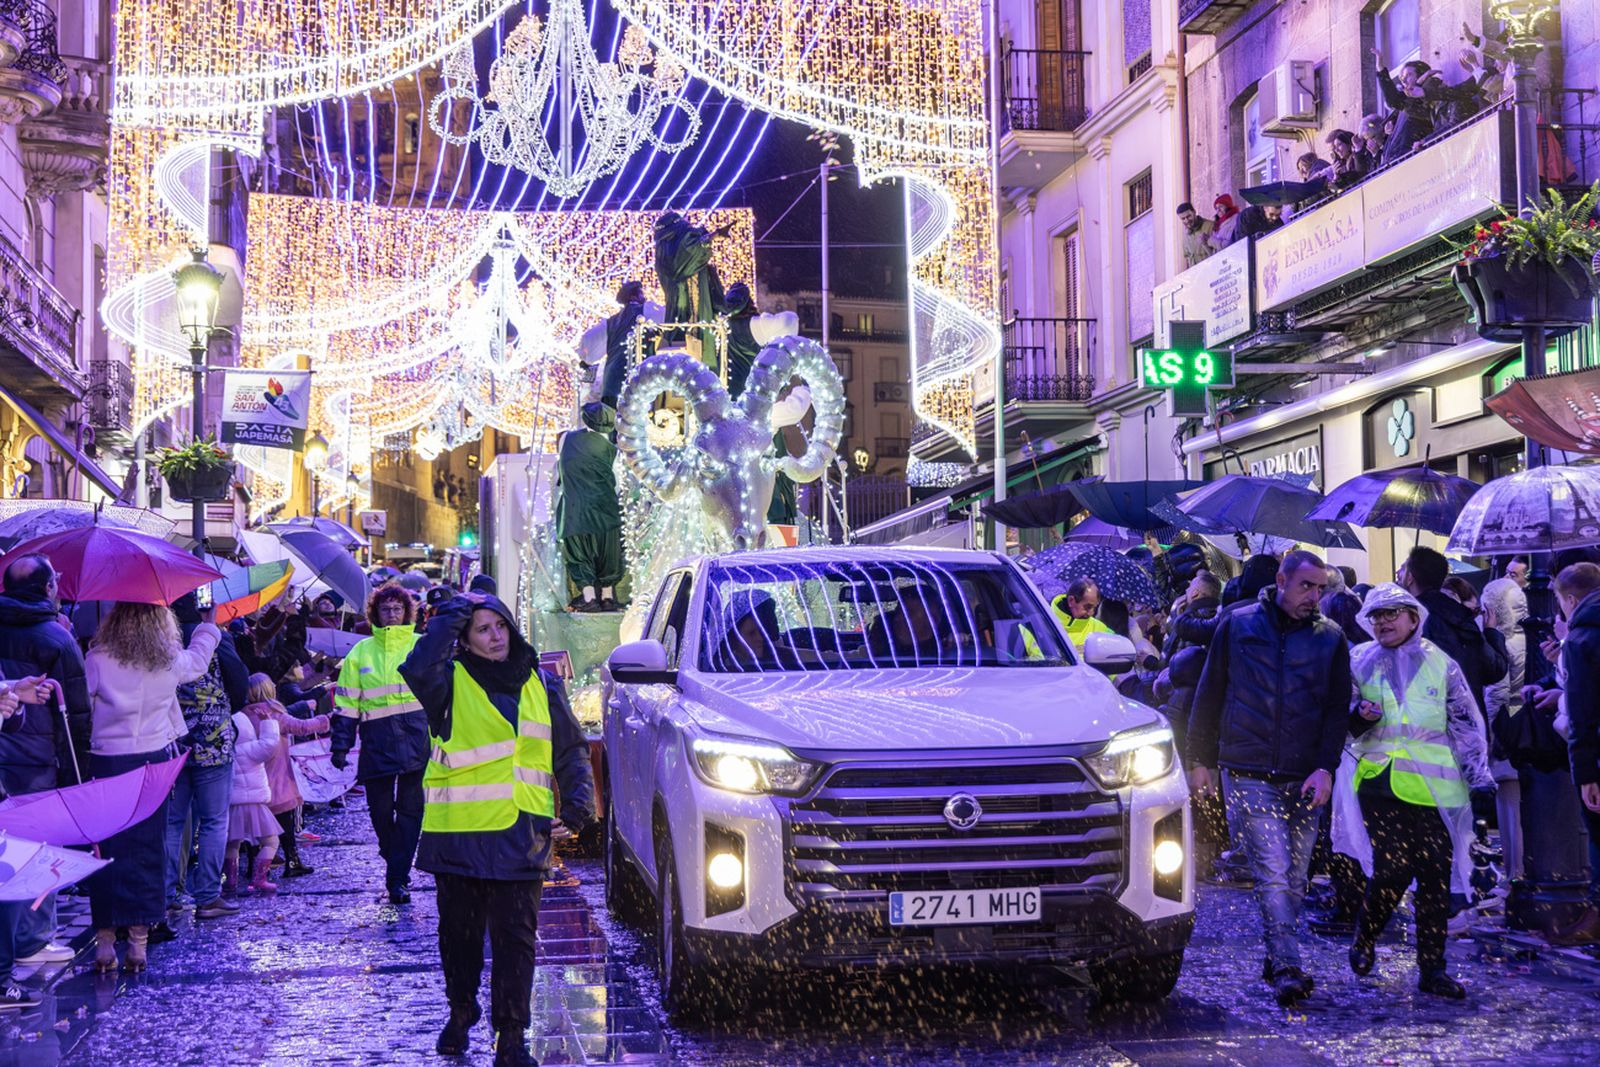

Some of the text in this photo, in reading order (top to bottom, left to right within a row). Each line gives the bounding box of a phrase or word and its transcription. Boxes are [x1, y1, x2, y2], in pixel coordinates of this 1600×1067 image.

[1194, 352, 1214, 384] 9
[235, 423, 293, 435] DACIA
[235, 431, 293, 443] JAPEMASA
[1250, 445, 1320, 478] FARMACIA
[911, 891, 1037, 920] 2741 MHG
